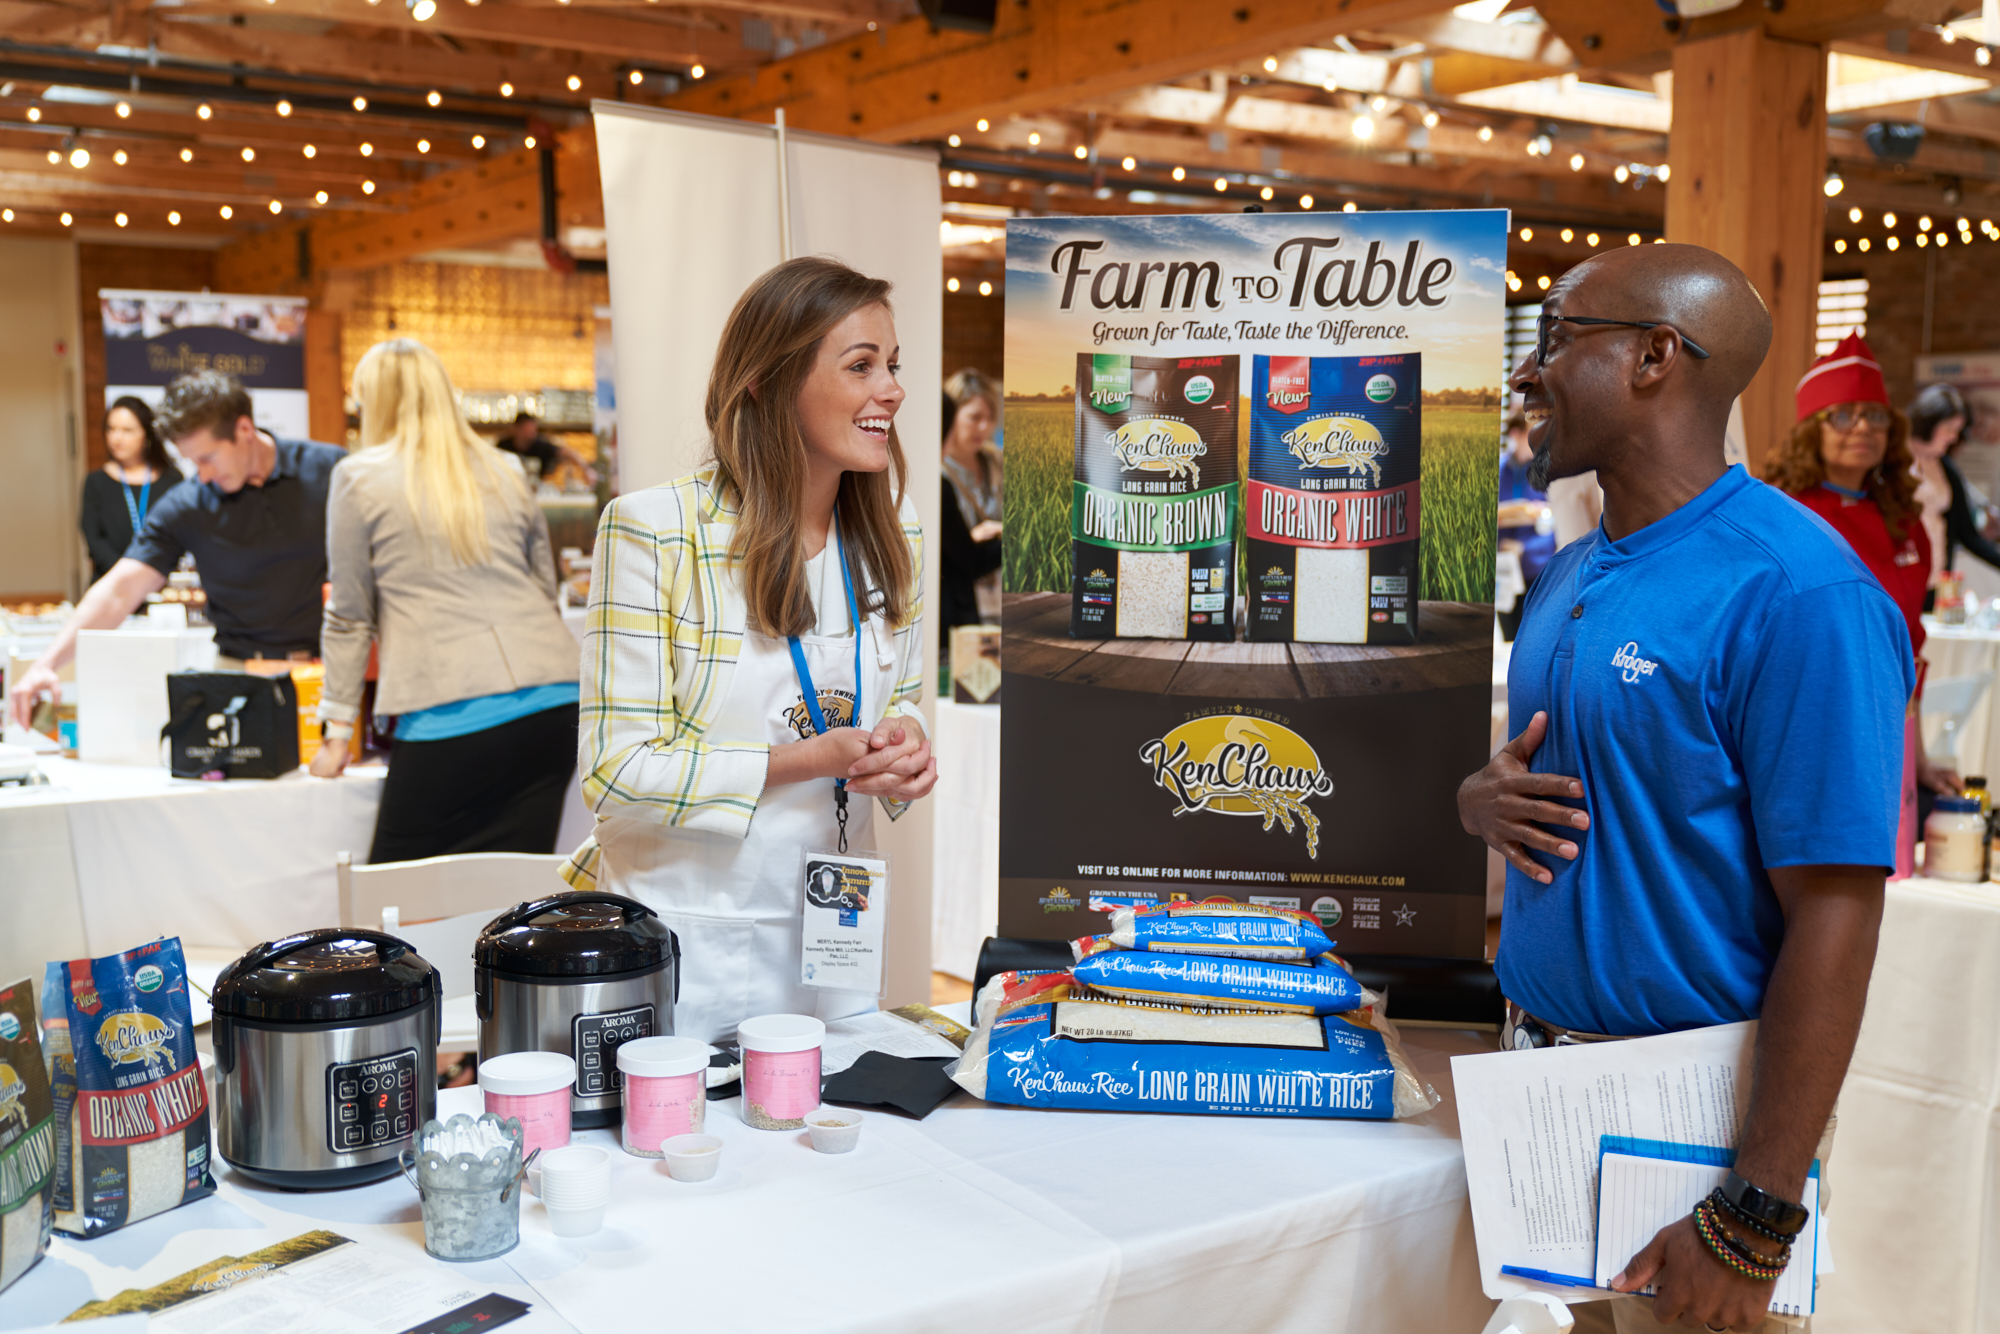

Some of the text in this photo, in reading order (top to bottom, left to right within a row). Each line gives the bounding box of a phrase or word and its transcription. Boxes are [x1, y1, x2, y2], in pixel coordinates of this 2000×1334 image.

[1050, 236, 1453, 311] Farm TO Table
[1092, 320, 1410, 346] Grown for Taste, Taste the Difference.
[1272, 377, 1305, 386] GLUTEN-FREE
[1089, 388, 1133, 405] New
[1188, 389, 1210, 397] ORGANIC
[1266, 389, 1311, 405] New
[1369, 388, 1392, 396] ORGANIC
[1128, 414, 1185, 422] FAMILY OWNED
[1307, 412, 1365, 421] FAMILY OWNED
[1105, 430, 1207, 468] KenChaux
[1281, 430, 1389, 466] KenChaux
[1122, 481, 1187, 493] LONG GRAIN RICE
[1301, 478, 1367, 490] LONG GRAIN RICE
[1083, 490, 1226, 545] ORGANIC BROWN
[1262, 488, 1406, 542] ORGANIC WHITE
[1611, 641, 1658, 683] Kroger
[1184, 705, 1290, 725] FAMILY OWNED
[1139, 738, 1333, 812] KenChaux
[841, 866, 884, 878] Innovation
[1077, 865, 1406, 886] VISIT US ONLINE FOR MORE INFORMATION: WWW.KENCHAUX.COM
[840, 875, 873, 886] Summit
[840, 885, 858, 894] 2019
[1236, 904, 1270, 915] WHITE
[1271, 910, 1294, 919] RICE
[1318, 903, 1336, 911] USDA
[1353, 903, 1380, 912] FREE
[1149, 921, 1190, 936] KenChaux
[1190, 921, 1212, 935] Rice
[1213, 922, 1237, 935] LONG
[1240, 922, 1267, 936] GRAIN
[1271, 923, 1301, 938] WHITE
[1353, 921, 1380, 929] FREE
[139, 970, 157, 980] USDA
[139, 976, 161, 988] ORGANIC
[1090, 956, 1347, 997] KenChaux Rice LONG GRAIN WHITE RICE
[73, 992, 99, 1008] New
[1067, 989, 1120, 1005] LONG
[1231, 987, 1295, 999] ENRICHED
[601, 1016, 636, 1028] AROMA
[1061, 1025, 1073, 1034] NET
[1074, 1028, 1085, 1036] WT
[1086, 1028, 1095, 1036] 20
[1106, 1028, 1133, 1037] (9.07KG)
[1334, 1029, 1364, 1040] LOW-FAT
[94, 1024, 176, 1064] KenChaux
[1334, 1035, 1366, 1045] GLUTEN
[1337, 1040, 1366, 1049] FREE
[359, 1061, 397, 1077] AROMA
[115, 1065, 166, 1088] LONG GRAIN RICE
[1007, 1066, 1374, 1110] KenChaux Rice LONG GRAIN WHITE RICE
[89, 1066, 202, 1139] ORGANIC WHITE
[378, 1094, 388, 1108] 2
[1208, 1105, 1300, 1114] ENRICHED
